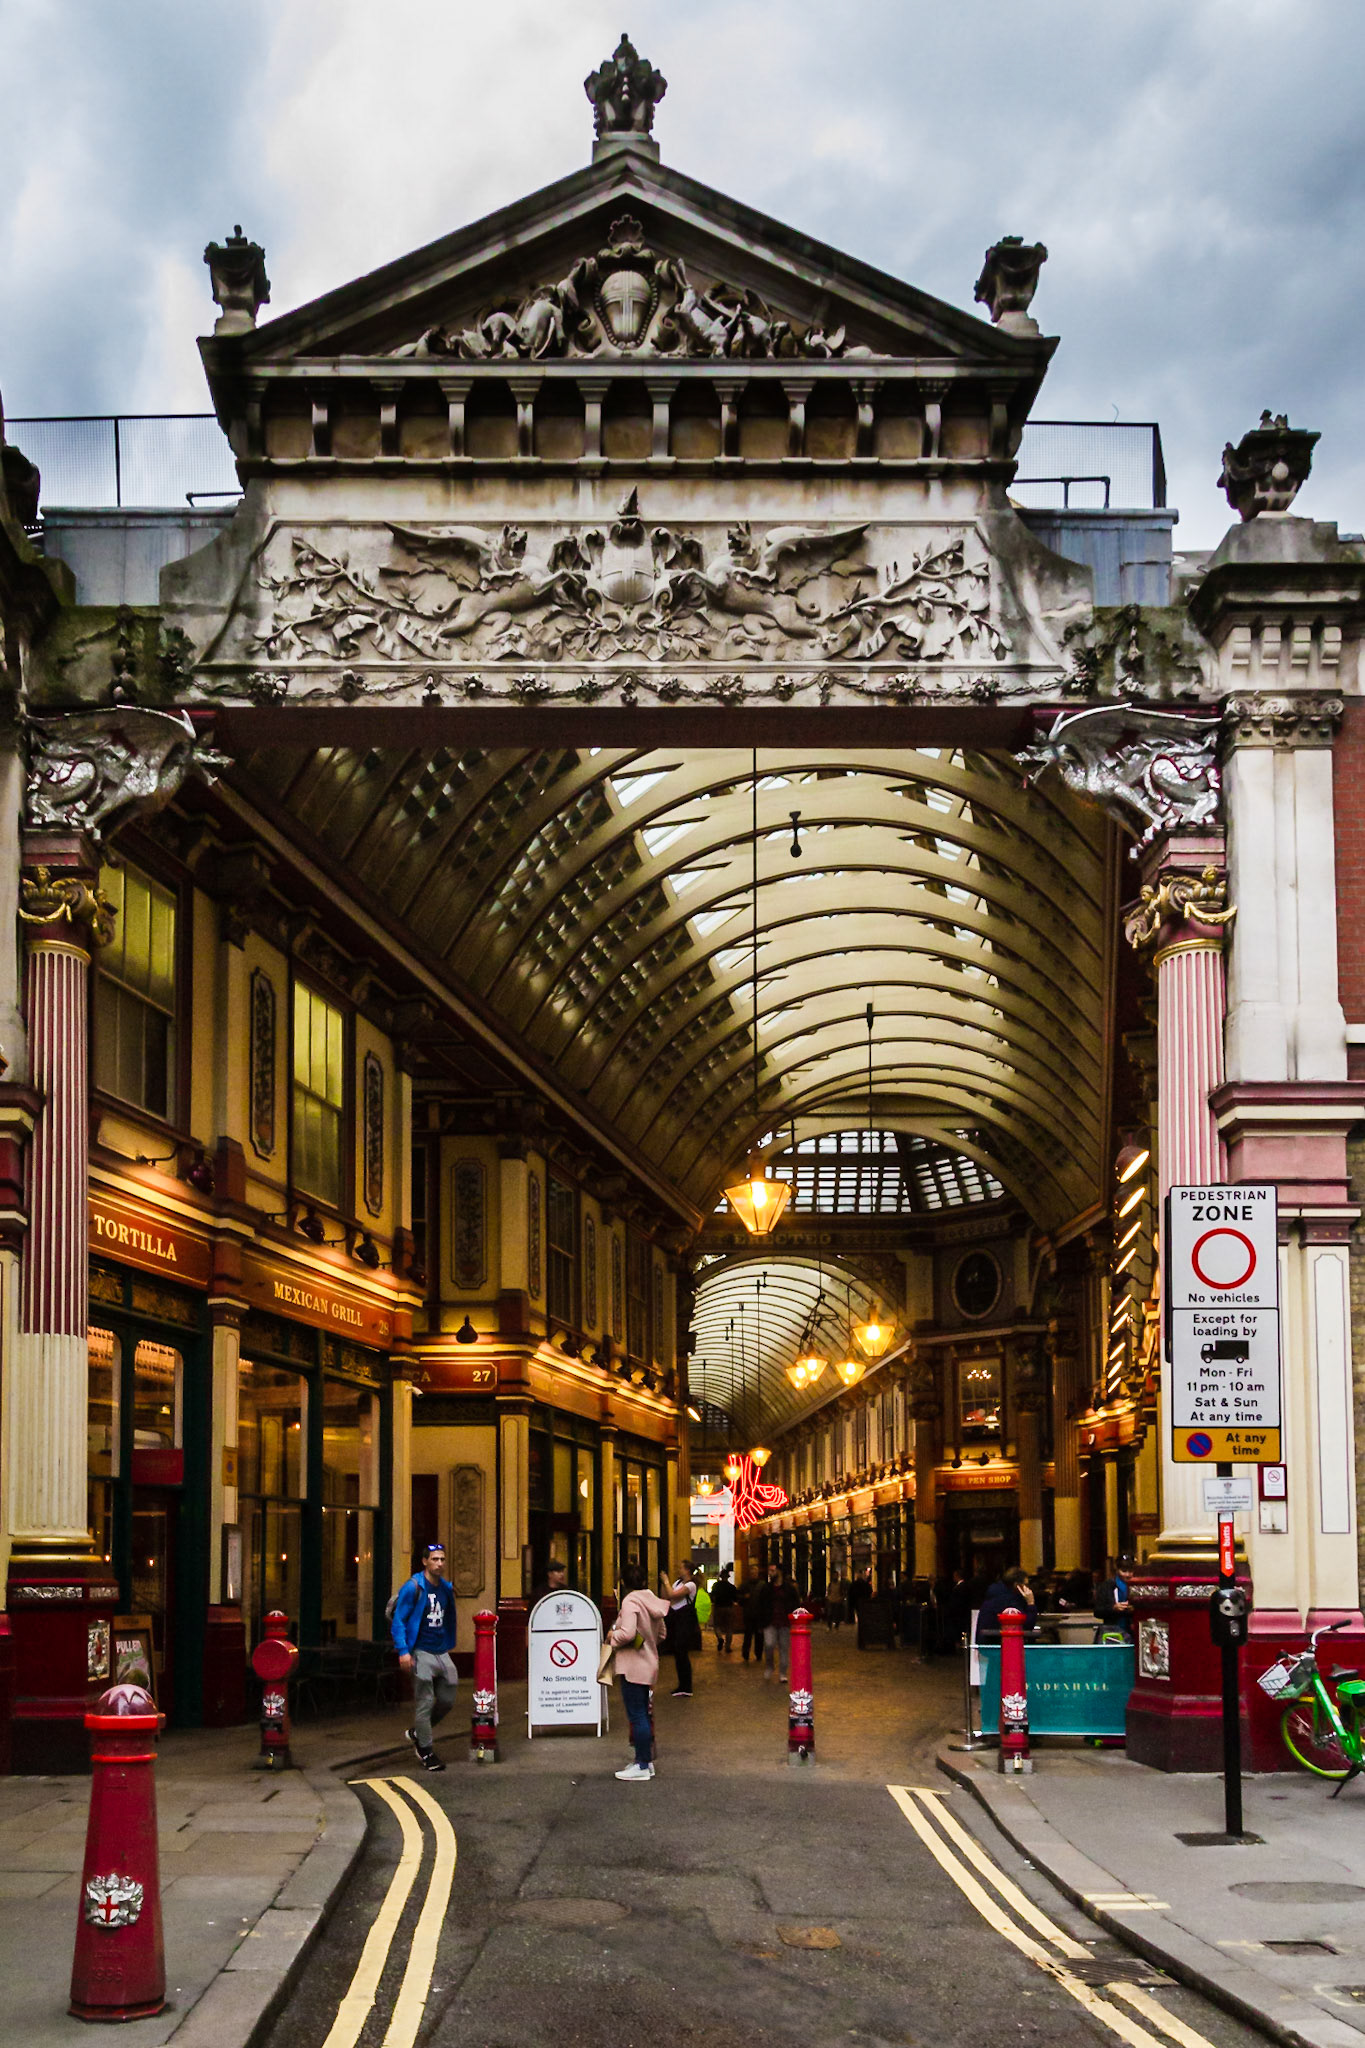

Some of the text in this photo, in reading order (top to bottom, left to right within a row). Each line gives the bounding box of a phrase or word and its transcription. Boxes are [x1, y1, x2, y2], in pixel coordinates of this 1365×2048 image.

[1180, 1190, 1267, 1201] PEDESTRIAN
[1192, 1205, 1253, 1221] ZONE
[94, 1213, 177, 1262] TORTILLA
[274, 1281, 328, 1314] MEXICAN
[331, 1302, 363, 1327] GRILL
[1188, 1293, 1260, 1303] No vehicles
[1193, 1313, 1257, 1326] Except for
[1193, 1326, 1257, 1338] loading by
[472, 1370, 491, 1382] 27
[1199, 1367, 1226, 1377] Mon
[1236, 1367, 1253, 1377] Fri
[1187, 1382, 1198, 1392] 11
[1200, 1384, 1219, 1394] pm
[1229, 1382, 1243, 1392] 10
[1246, 1384, 1265, 1392] am
[1195, 1397, 1258, 1407] Sat & Sun
[1190, 1411, 1263, 1424] At any time
[1226, 1433, 1267, 1445] At any
[1232, 1446, 1260, 1455] time
[968, 1477, 985, 1485] PEN
[988, 1475, 1011, 1484] SHOP
[1222, 1525, 1231, 1547] butts
[1225, 1551, 1233, 1570] gum
[426, 1593, 445, 1627] LA
[1025, 1682, 1110, 1691] EADENHALL
